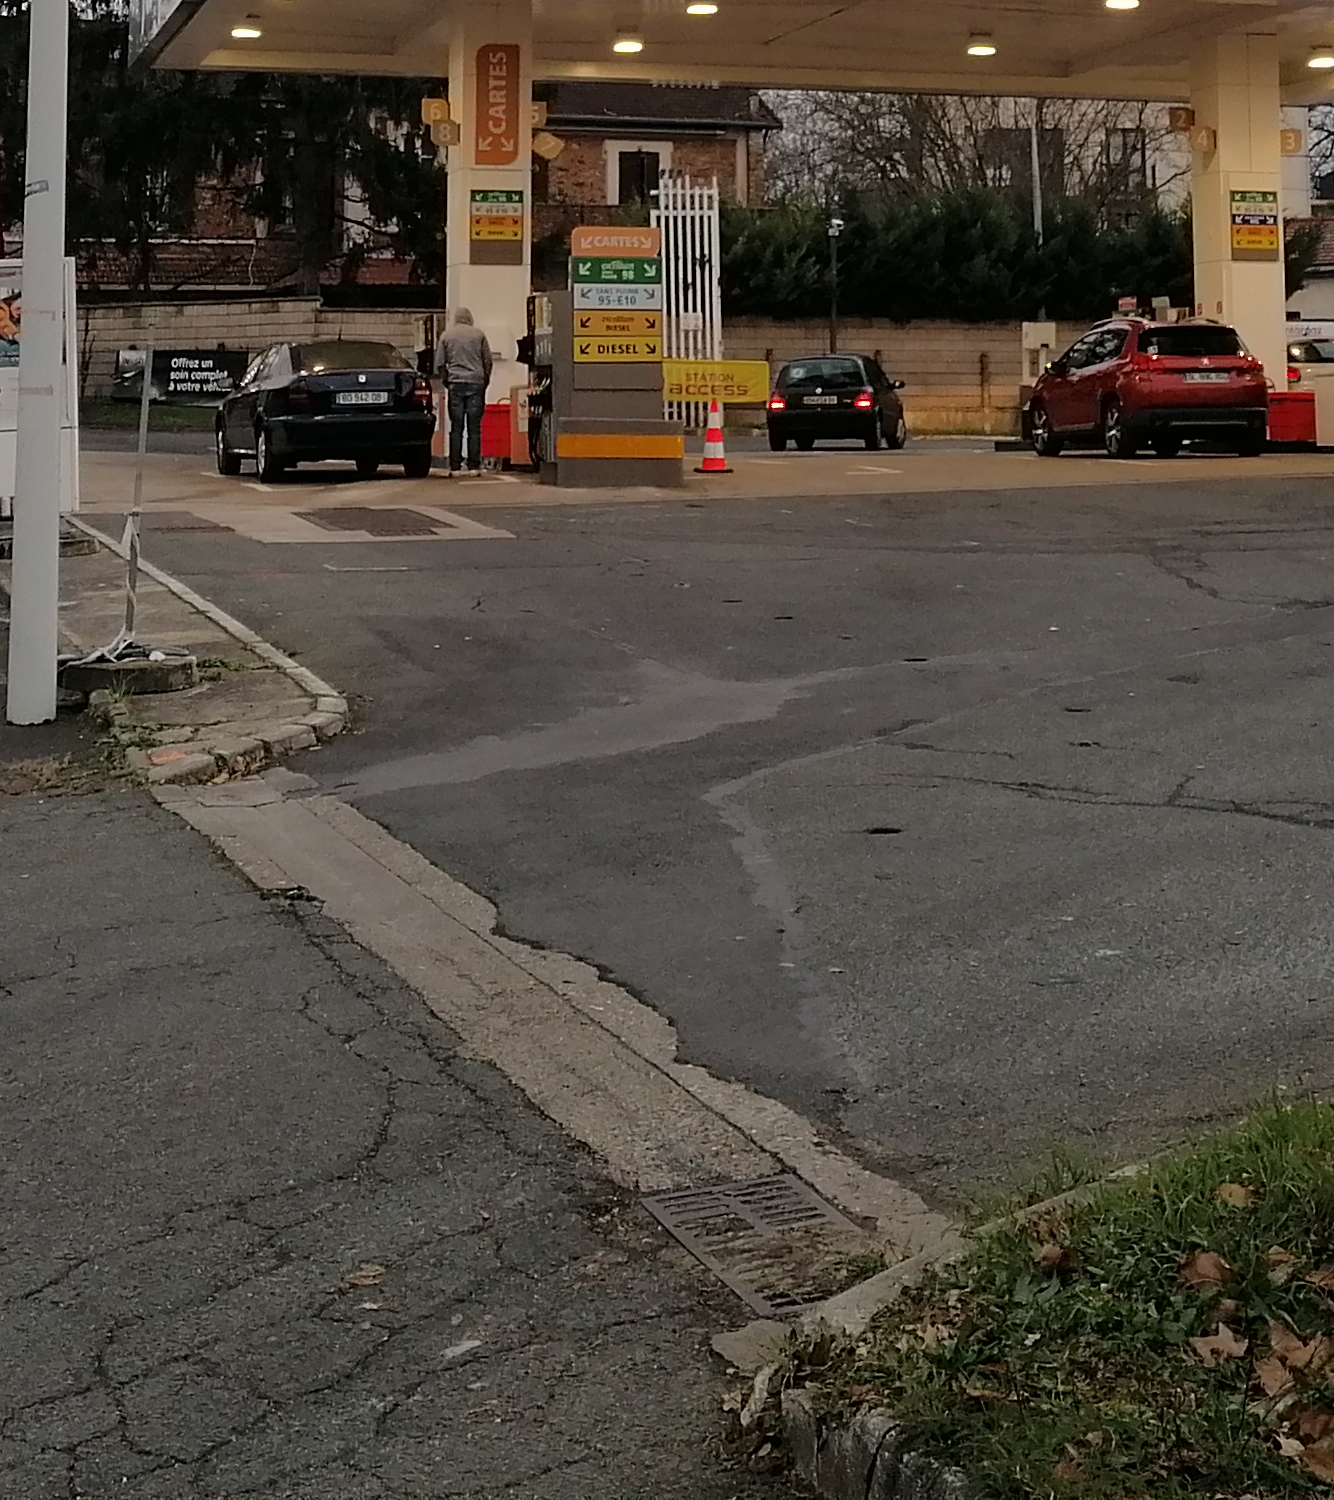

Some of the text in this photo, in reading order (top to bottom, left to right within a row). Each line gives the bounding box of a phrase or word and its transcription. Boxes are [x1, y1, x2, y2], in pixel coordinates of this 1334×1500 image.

[488, 52, 507, 135] CARTES
[430, 103, 441, 120] 6
[1176, 111, 1186, 126] 2
[439, 123, 451, 142] 8
[1196, 129, 1208, 146] 4
[1285, 132, 1295, 149] 3
[594, 236, 639, 248] CARTES
[598, 295, 637, 306] 95-E10
[597, 343, 639, 354] DIESEL
[171, 357, 213, 368] Offrez un
[170, 369, 228, 382] soin complet
[685, 373, 734, 383] STATION
[176, 382, 201, 392] votre
